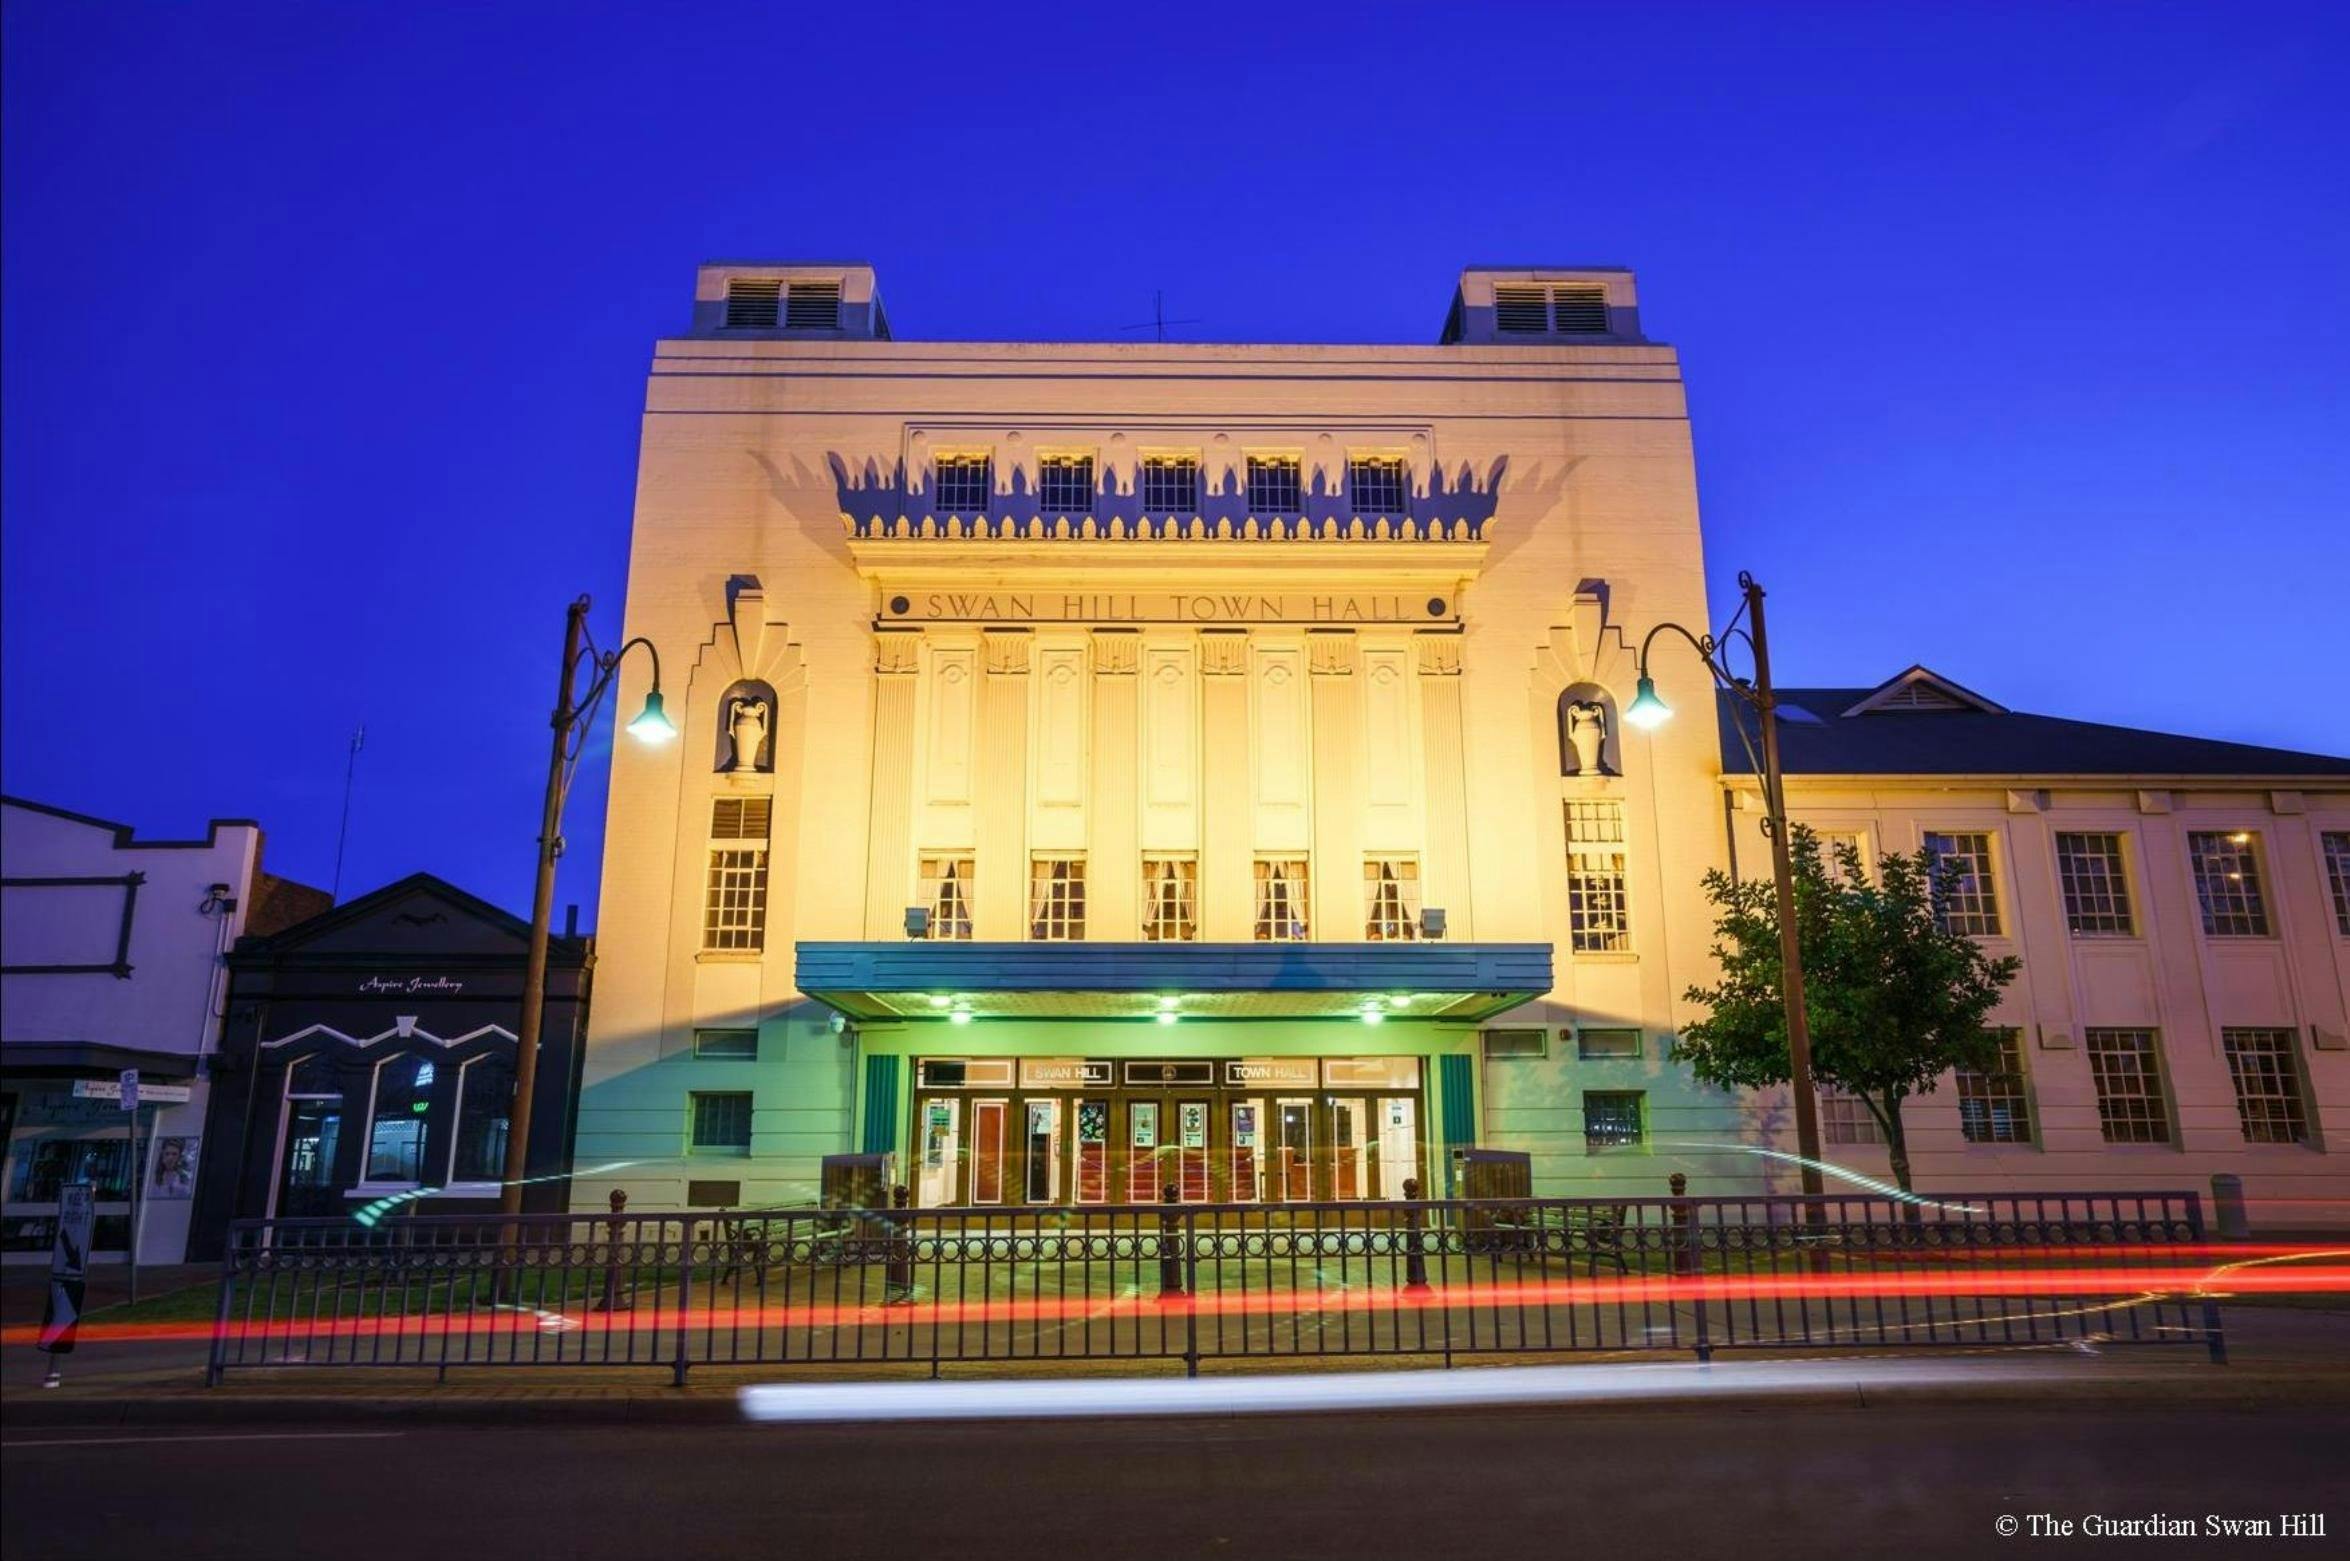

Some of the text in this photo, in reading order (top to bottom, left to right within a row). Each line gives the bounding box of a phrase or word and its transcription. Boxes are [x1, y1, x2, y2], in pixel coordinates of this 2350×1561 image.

[927, 593, 1411, 621] SWAN HILL TOWN HALL
[359, 976, 463, 994] Aspire Jewellery
[1034, 1066, 1102, 1080] SWAN HILL
[1233, 1066, 1308, 1080] TOWN HALL
